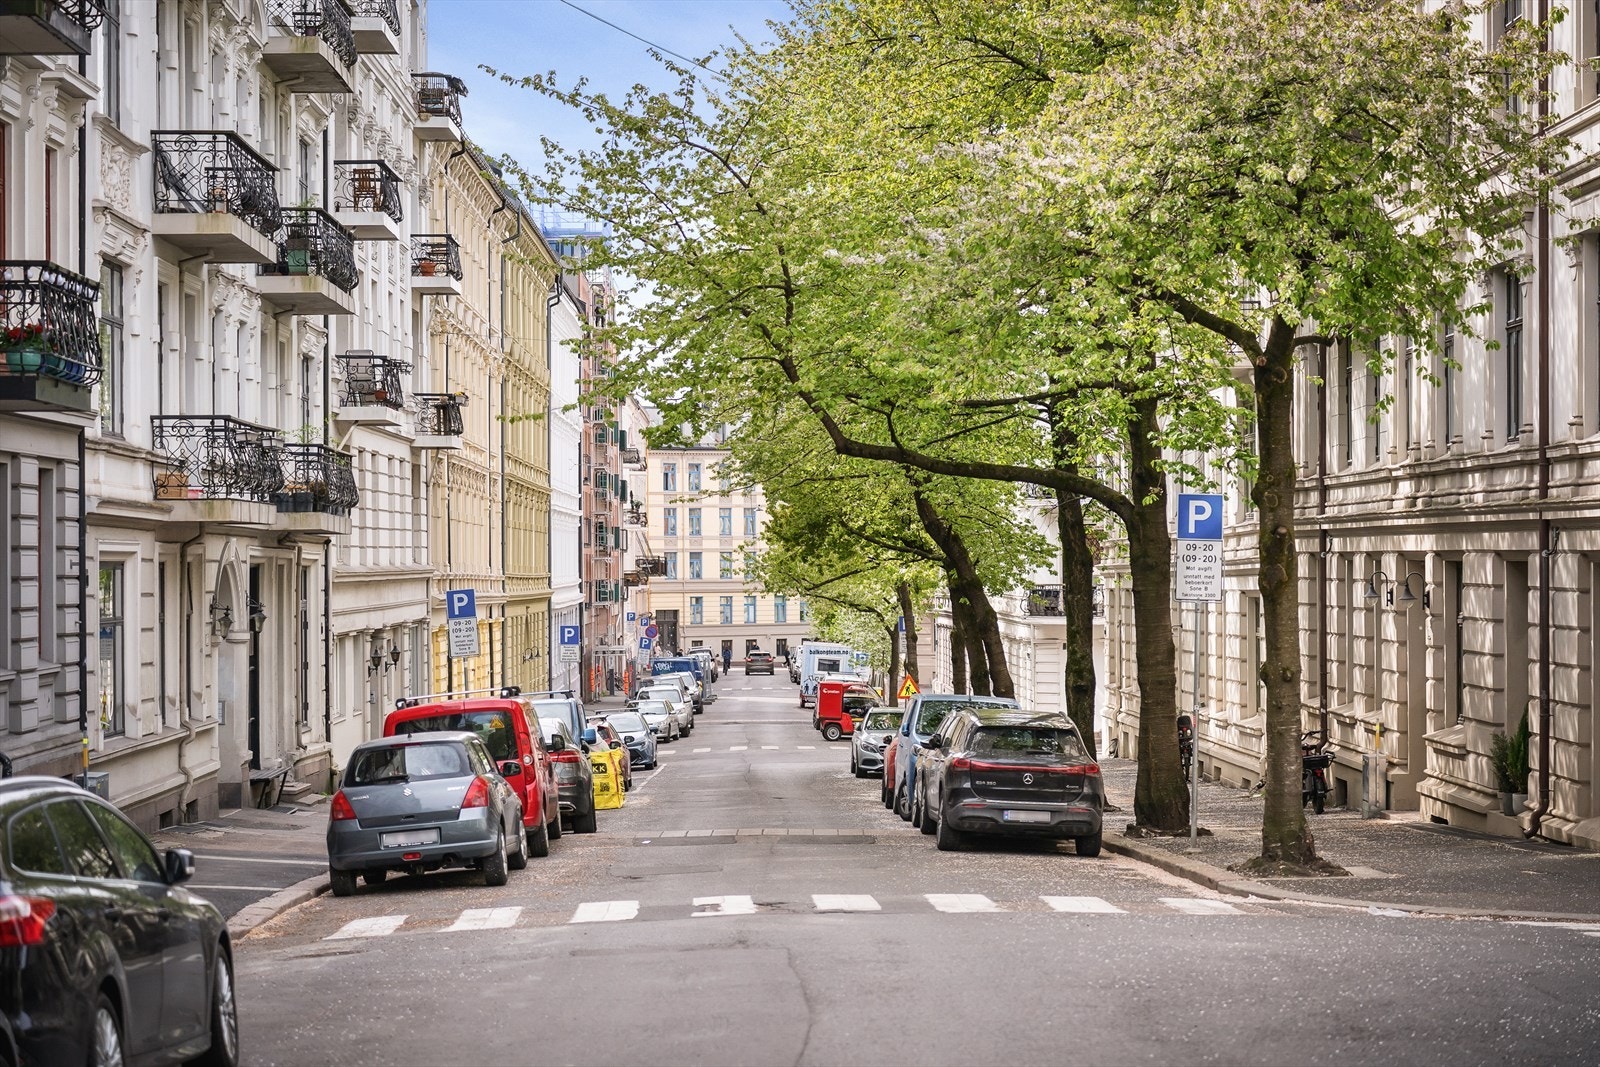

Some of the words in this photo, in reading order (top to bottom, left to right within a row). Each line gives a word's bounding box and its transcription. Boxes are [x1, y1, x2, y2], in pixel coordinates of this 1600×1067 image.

[1189, 500, 1212, 533] P
[1185, 543, 1214, 552] 09-20
[1182, 554, 1217, 563] (09-20)
[453, 594, 468, 615] P
[564, 628, 575, 643] P
[641, 639, 649, 648] P
